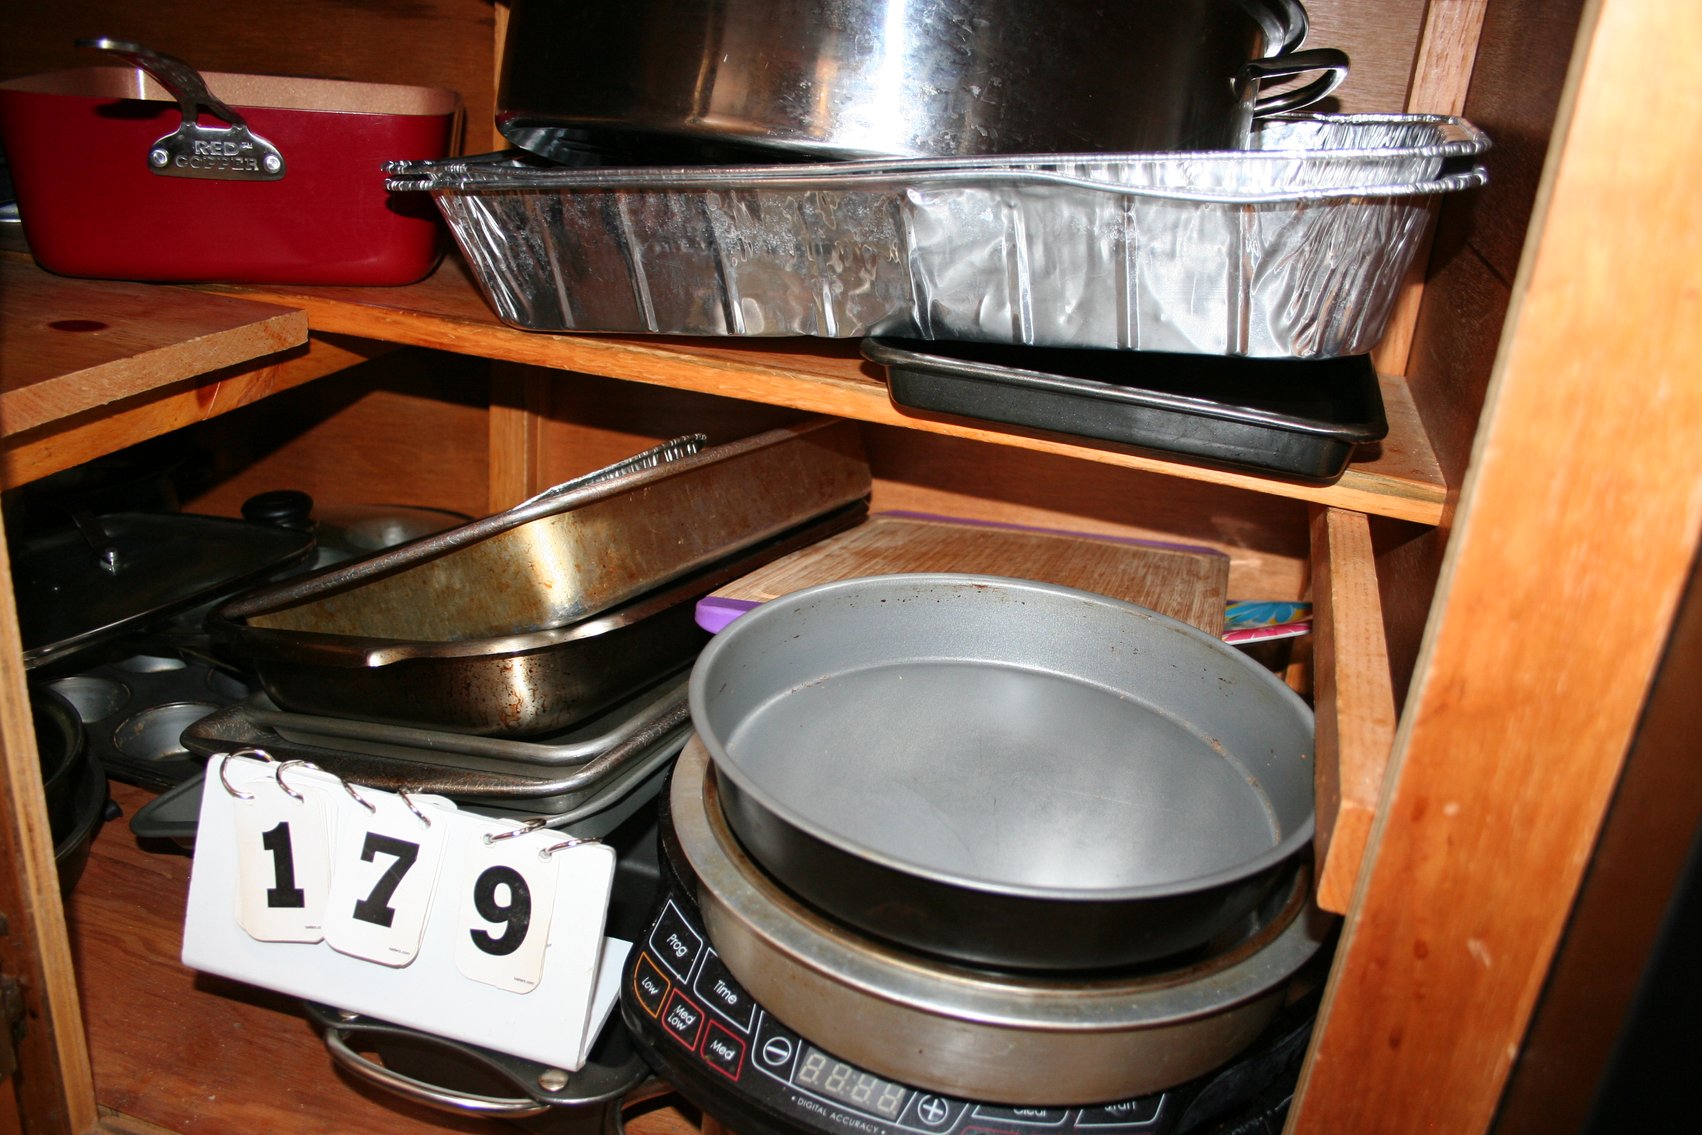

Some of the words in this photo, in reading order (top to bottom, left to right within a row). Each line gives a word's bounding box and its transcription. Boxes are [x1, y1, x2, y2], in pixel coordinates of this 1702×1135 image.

[175, 155, 260, 171] COPPER
[261, 821, 306, 909] 1
[352, 831, 420, 928] 7
[469, 865, 532, 956] 9
[666, 933, 688, 958] Prog
[641, 976, 659, 995] Low
[713, 979, 738, 1005] Time
[667, 1012, 687, 1031] Low
[673, 1004, 696, 1025] Med
[709, 1039, 735, 1061] Med
[797, 1097, 828, 1118] DIGITAL
[829, 1112, 879, 1134] ACCURACY
